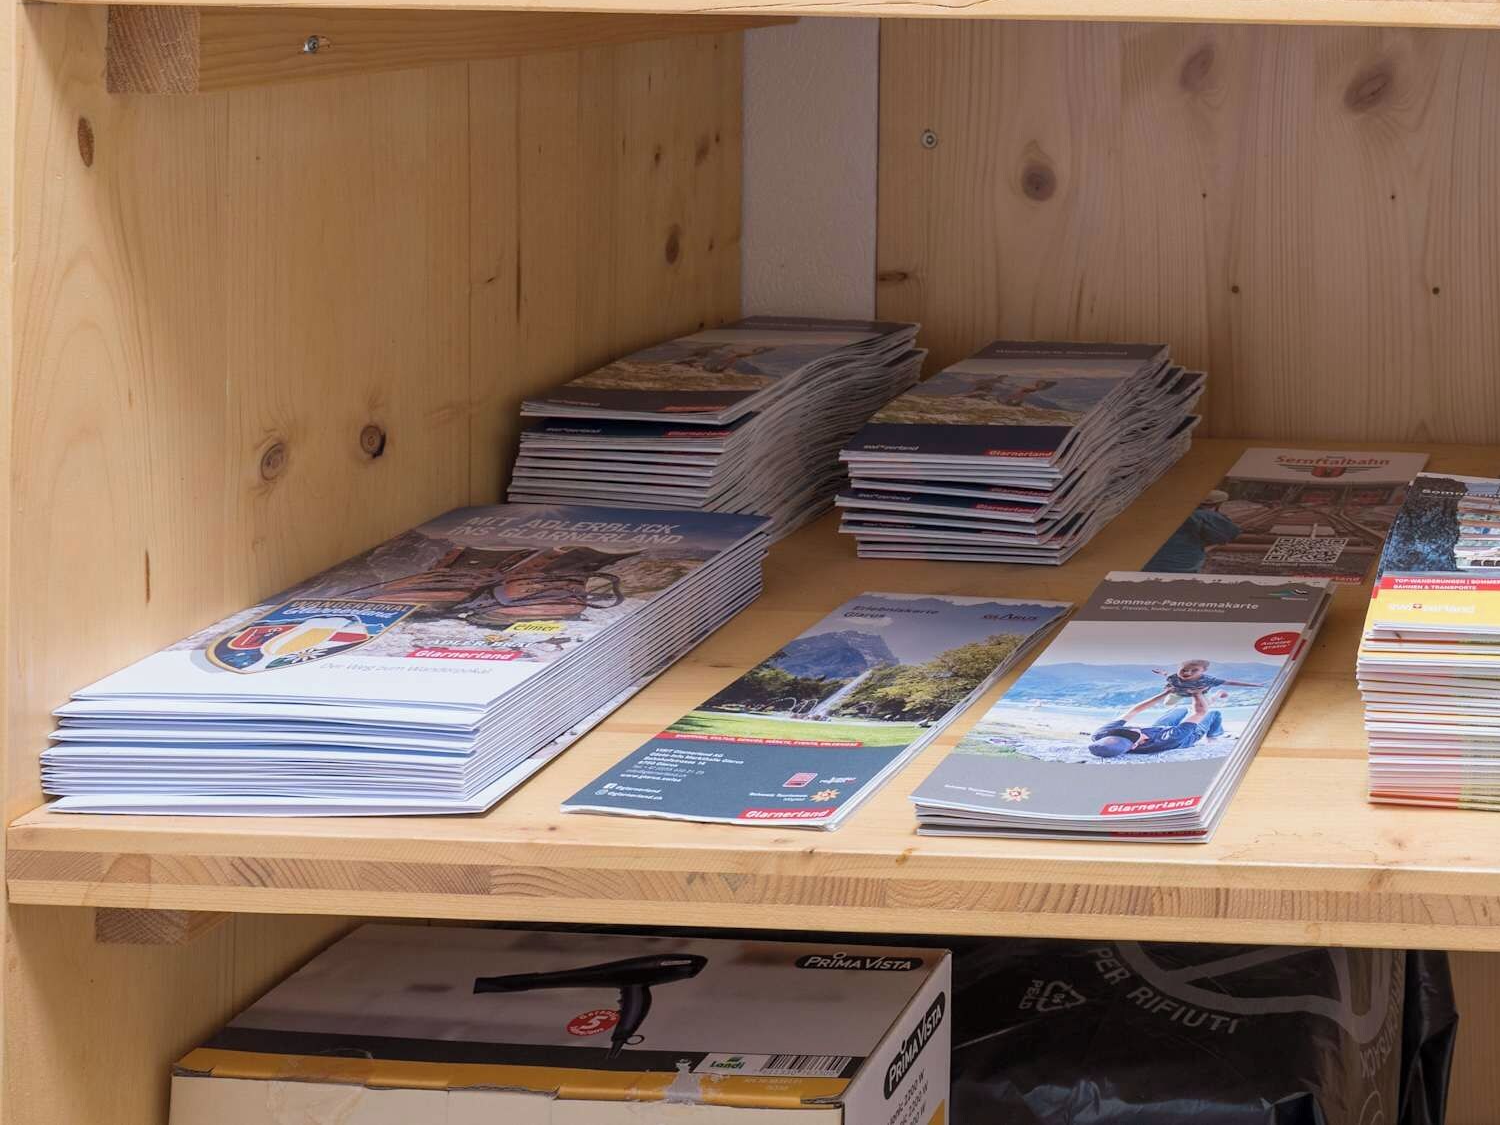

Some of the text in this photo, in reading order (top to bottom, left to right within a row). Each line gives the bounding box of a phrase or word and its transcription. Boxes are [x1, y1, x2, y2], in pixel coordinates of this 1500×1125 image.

[1276, 454, 1391, 466] Sernftalbahn
[463, 517, 680, 533] MIT ADLERBLICK
[450, 527, 684, 544] INS GLARNERLAND
[853, 605, 939, 615] Erlebniskarte
[1104, 598, 1260, 610] Sommer-Panoramakarte
[844, 611, 886, 619] Glarus
[415, 650, 514, 661] Glarnerland
[1108, 799, 1194, 813] Glarnerland
[746, 810, 830, 818] Glarnerland
[1088, 947, 1240, 1034] PER RIFIUTI
[580, 1016, 609, 1030] 5
